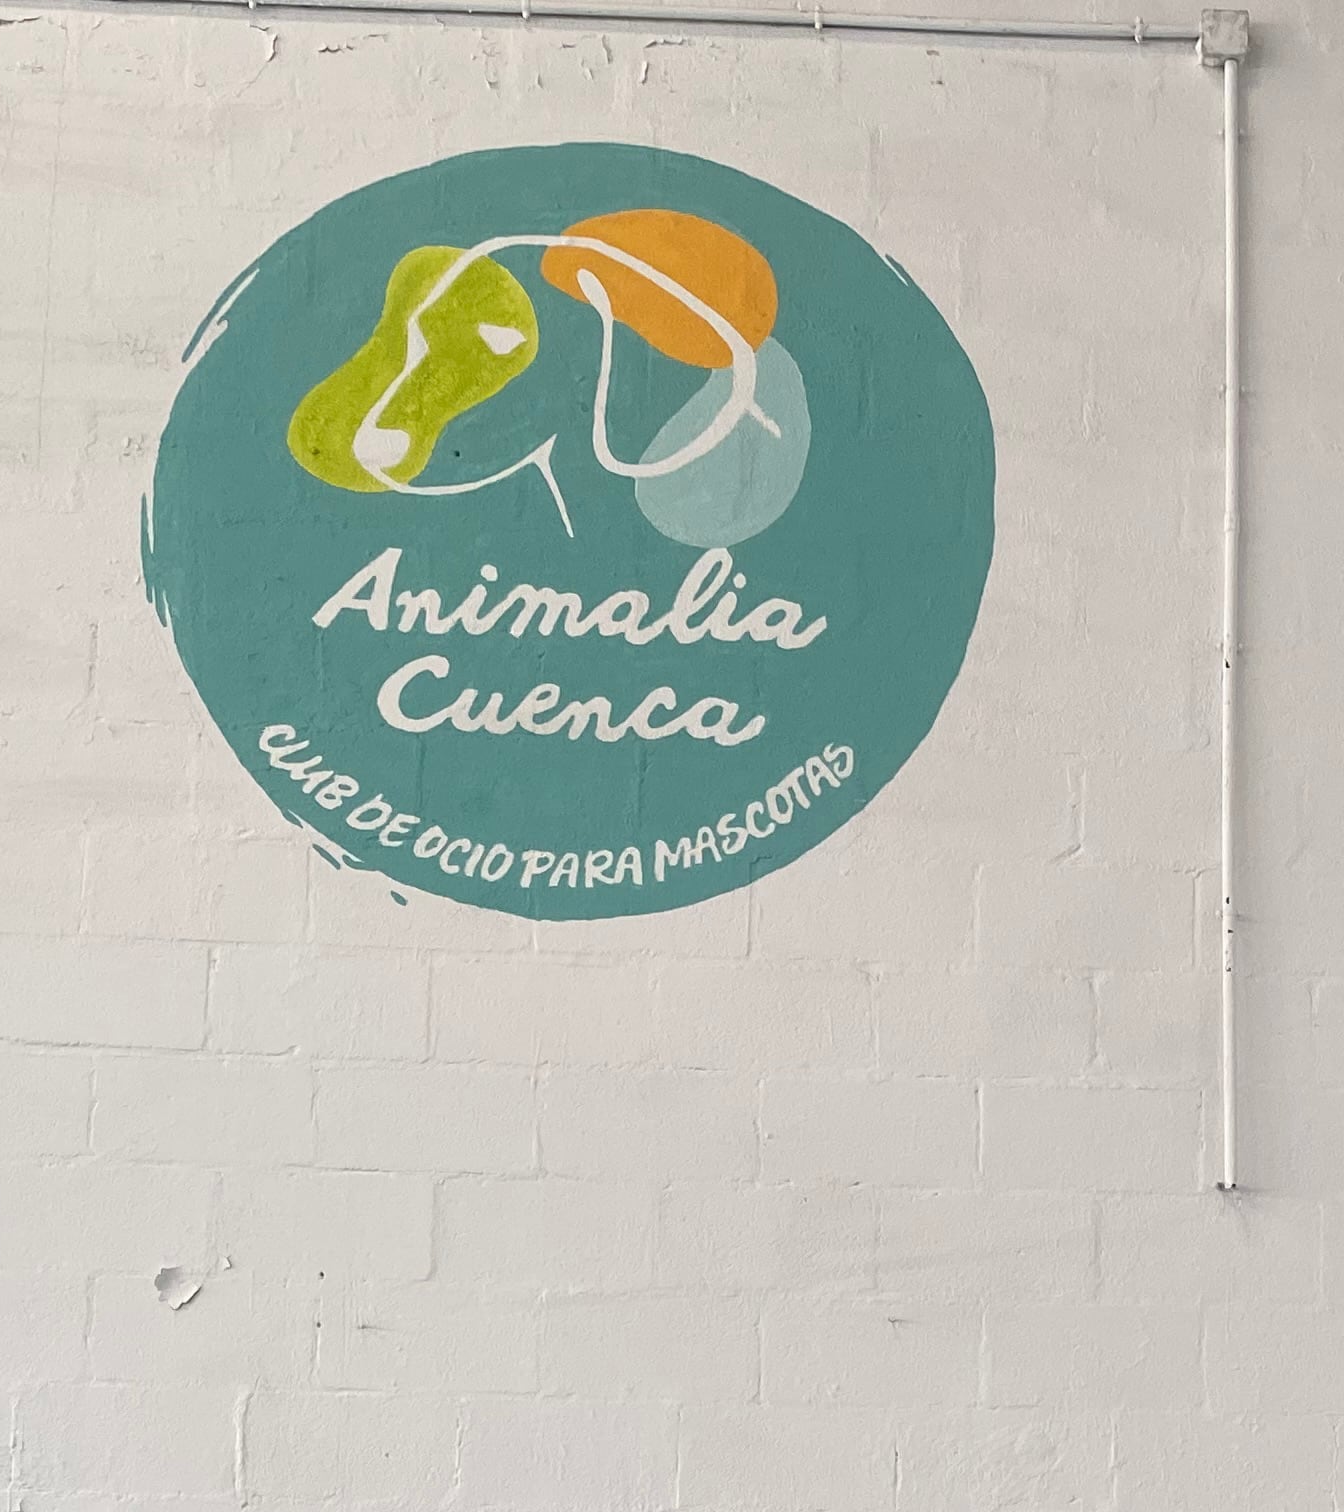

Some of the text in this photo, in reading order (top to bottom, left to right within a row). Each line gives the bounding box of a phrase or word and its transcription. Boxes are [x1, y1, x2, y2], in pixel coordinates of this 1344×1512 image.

[312, 547, 827, 650] Animalia
[377, 655, 766, 746] Cuenca
[258, 724, 855, 888] CLUB DE OCIO PARA MASCOTAS
